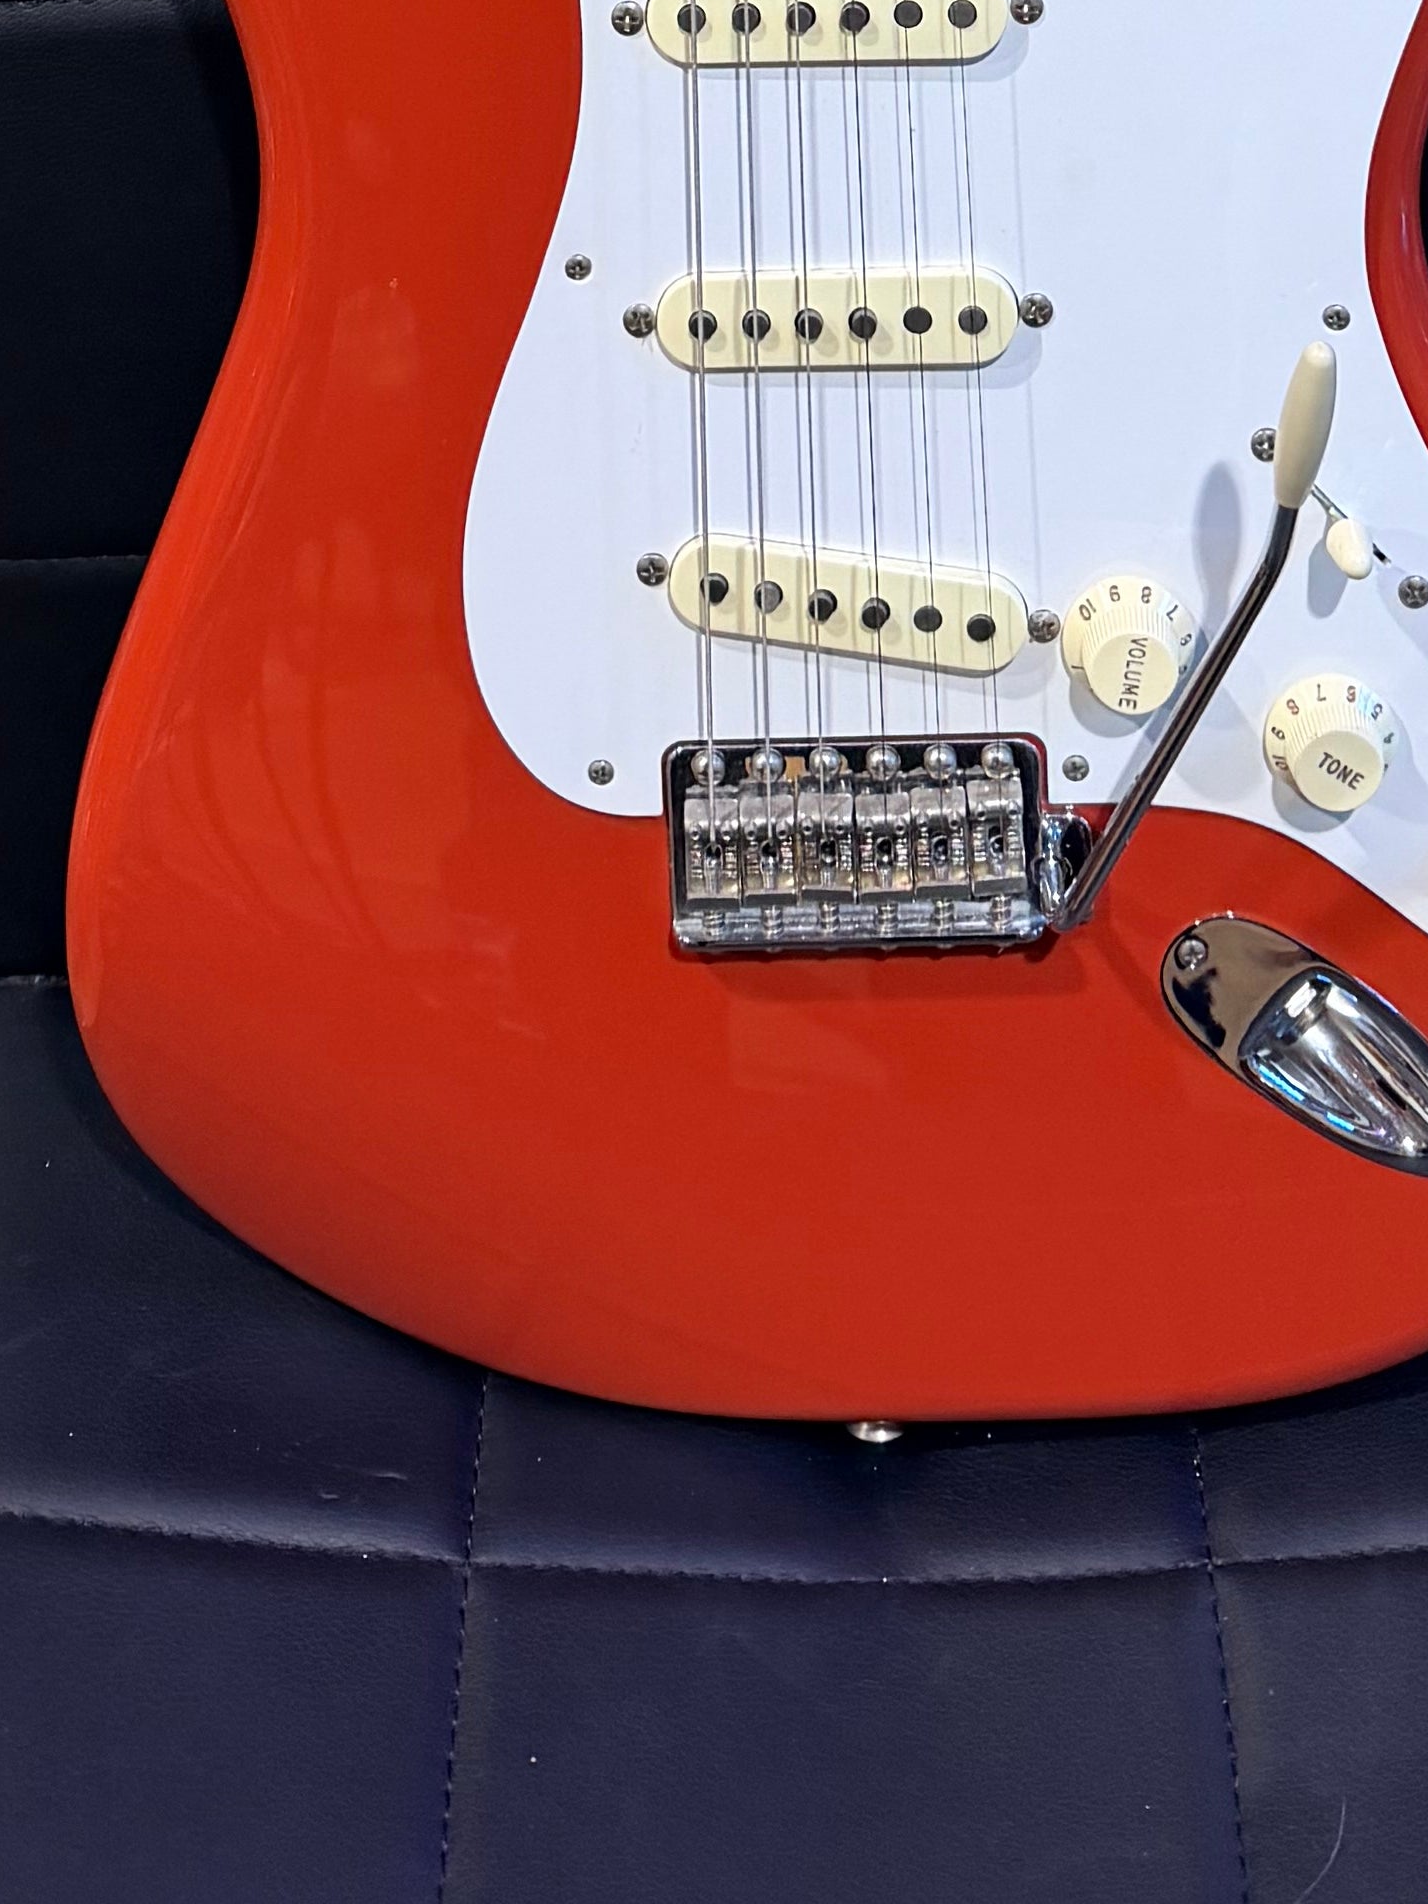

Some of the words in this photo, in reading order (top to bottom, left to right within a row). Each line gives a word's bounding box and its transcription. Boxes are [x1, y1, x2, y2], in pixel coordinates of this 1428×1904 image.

[1141, 586, 1152, 604] 8
[1118, 637, 1148, 710] VOLUME
[1318, 751, 1365, 791] TONE
